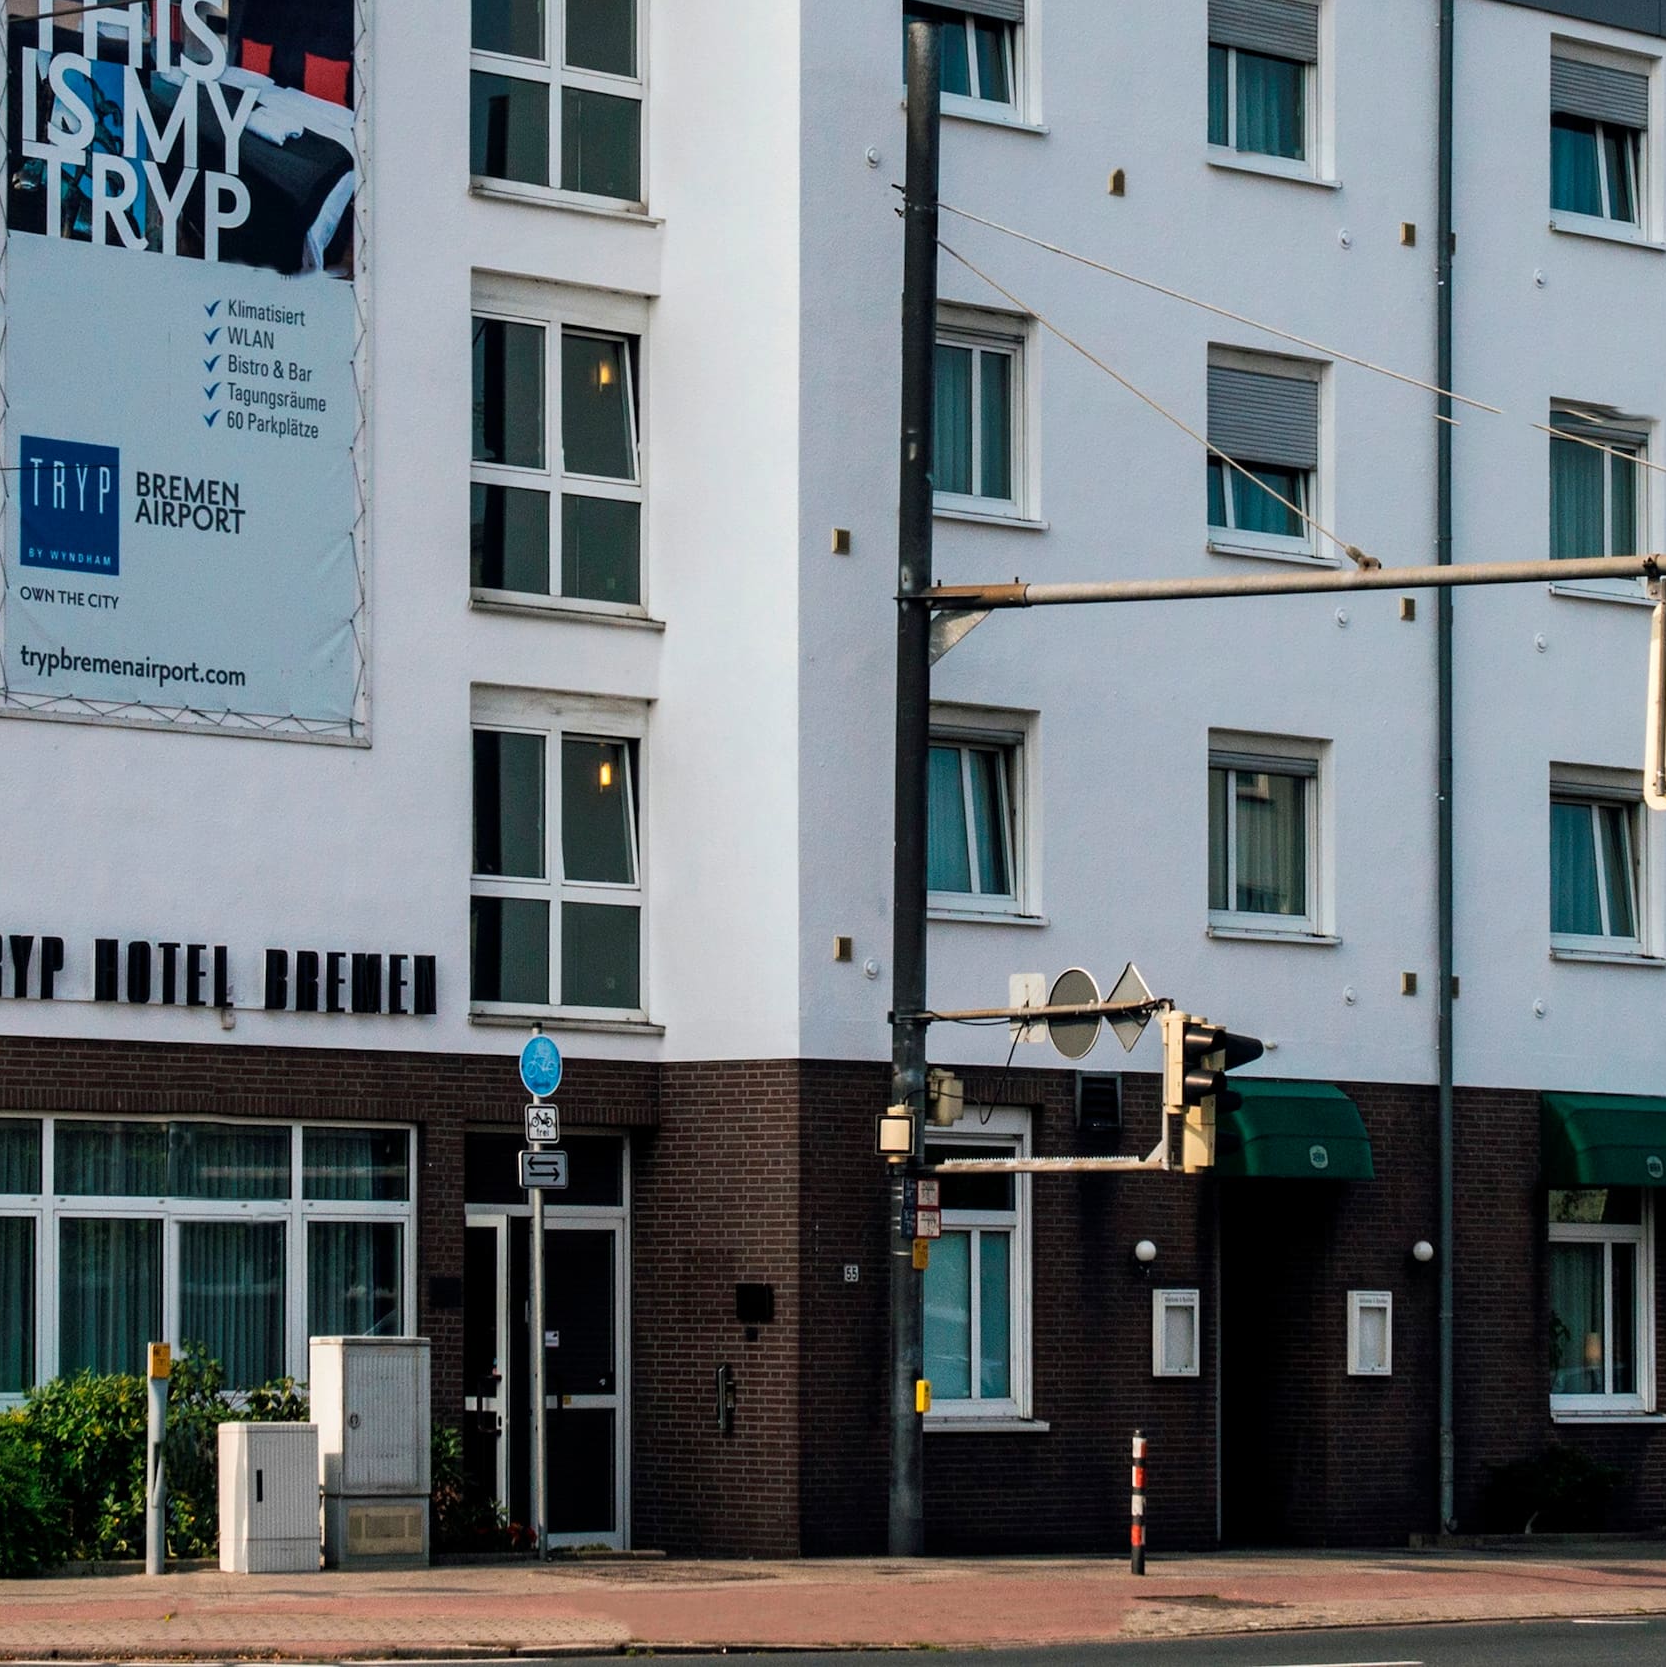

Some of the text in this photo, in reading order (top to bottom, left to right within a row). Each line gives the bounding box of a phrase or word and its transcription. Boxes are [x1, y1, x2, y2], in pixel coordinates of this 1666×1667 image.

[22, 46, 261, 177] IS MY
[22, 139, 251, 262] TRYP
[228, 299, 306, 326] Klimatisiert
[227, 326, 274, 349] WLAN
[228, 354, 312, 382] Bistro & Bar
[227, 382, 326, 412] Tagungsräume
[227, 410, 319, 439] 60 Parkplätze
[30, 457, 111, 514] TRYP
[136, 471, 239, 508] BREMEN
[135, 498, 246, 535] AIRPORT
[28, 547, 112, 566] BY WYNDHAM
[20, 586, 119, 610] OWN THE CITY
[20, 645, 246, 688] trypbremenairport.com
[95, 939, 233, 1008] HOTEL
[265, 948, 437, 1015] BREMEN
[536, 1127, 550, 1138] frei
[846, 1267, 858, 1280] 55
